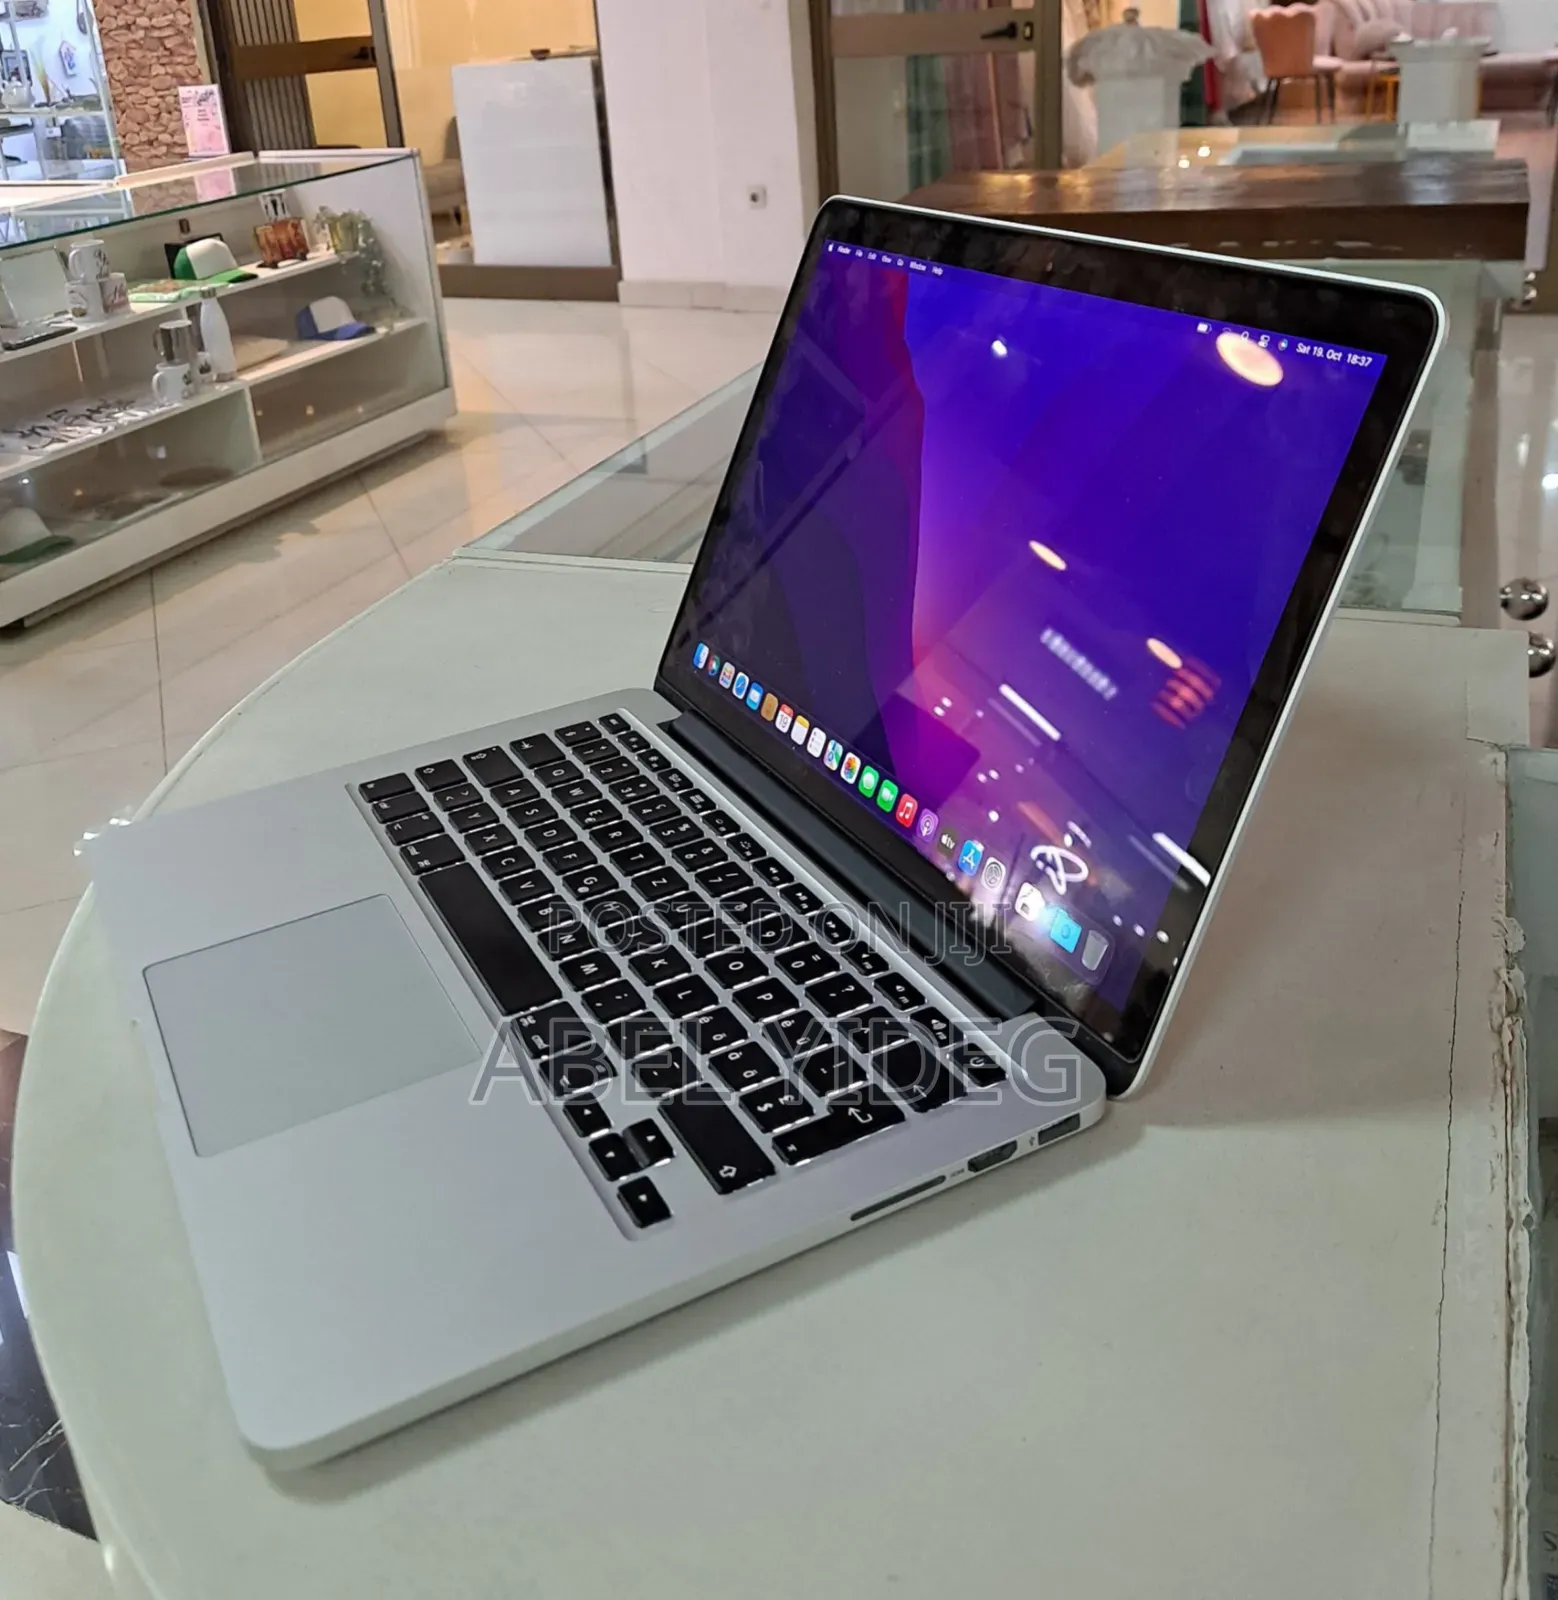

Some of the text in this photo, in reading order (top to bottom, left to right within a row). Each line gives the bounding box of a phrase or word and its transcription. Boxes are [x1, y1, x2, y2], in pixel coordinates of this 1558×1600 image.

[1296, 342, 1311, 355] Sat
[1326, 348, 1343, 362] Oct
[1347, 353, 1372, 367] 18:37
[569, 787, 585, 797] W
[483, 833, 498, 843] X
[501, 857, 516, 866] C
[519, 881, 535, 890] V
[651, 877, 668, 887] Z
[538, 906, 553, 916] B
[603, 901, 620, 912] H
[676, 903, 692, 913] U
[560, 934, 576, 944] N
[651, 958, 668, 969] K
[580, 963, 599, 975] M
[677, 989, 692, 999] L
[757, 992, 774, 1001] P
[757, 1102, 773, 1112] $
